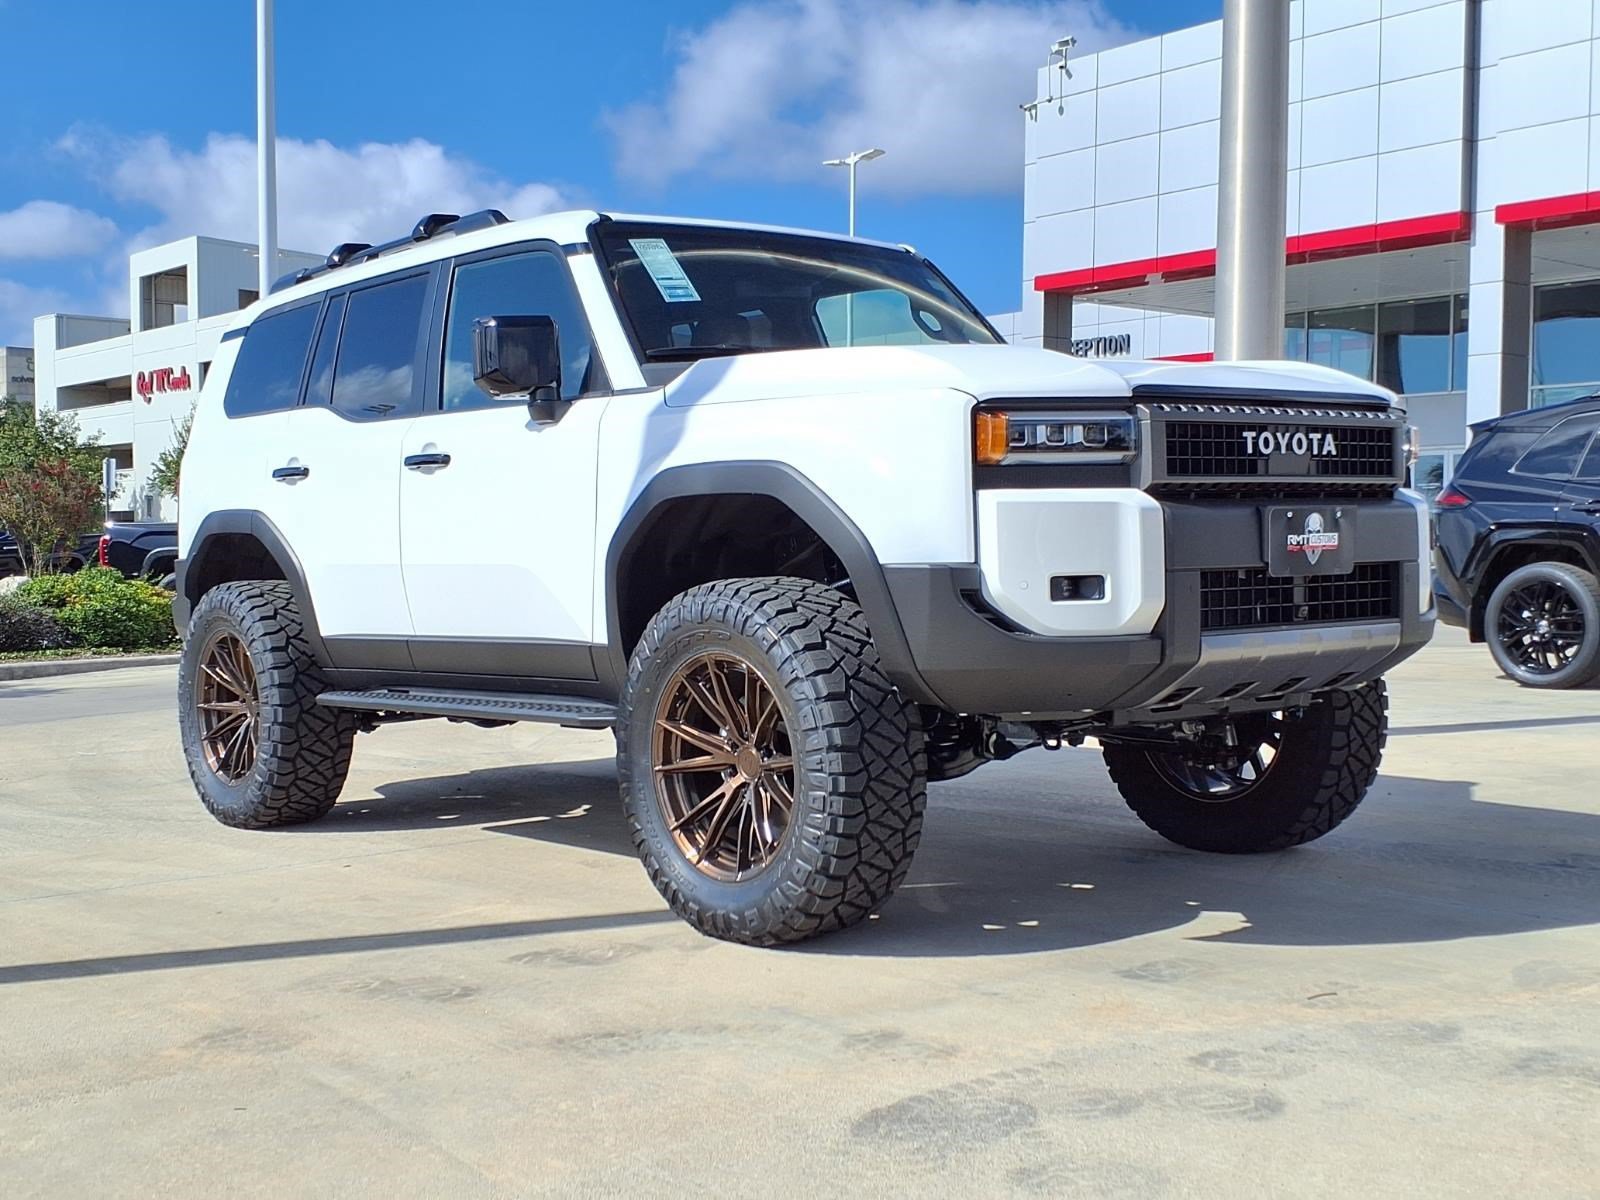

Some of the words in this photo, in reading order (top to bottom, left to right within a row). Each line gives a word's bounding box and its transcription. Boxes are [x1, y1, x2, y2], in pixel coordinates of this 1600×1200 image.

[1072, 333, 1131, 358] EPTION
[11, 375, 35, 384] solve
[1242, 431, 1337, 456] TOYOTA
[1287, 534, 1309, 545] RMT
